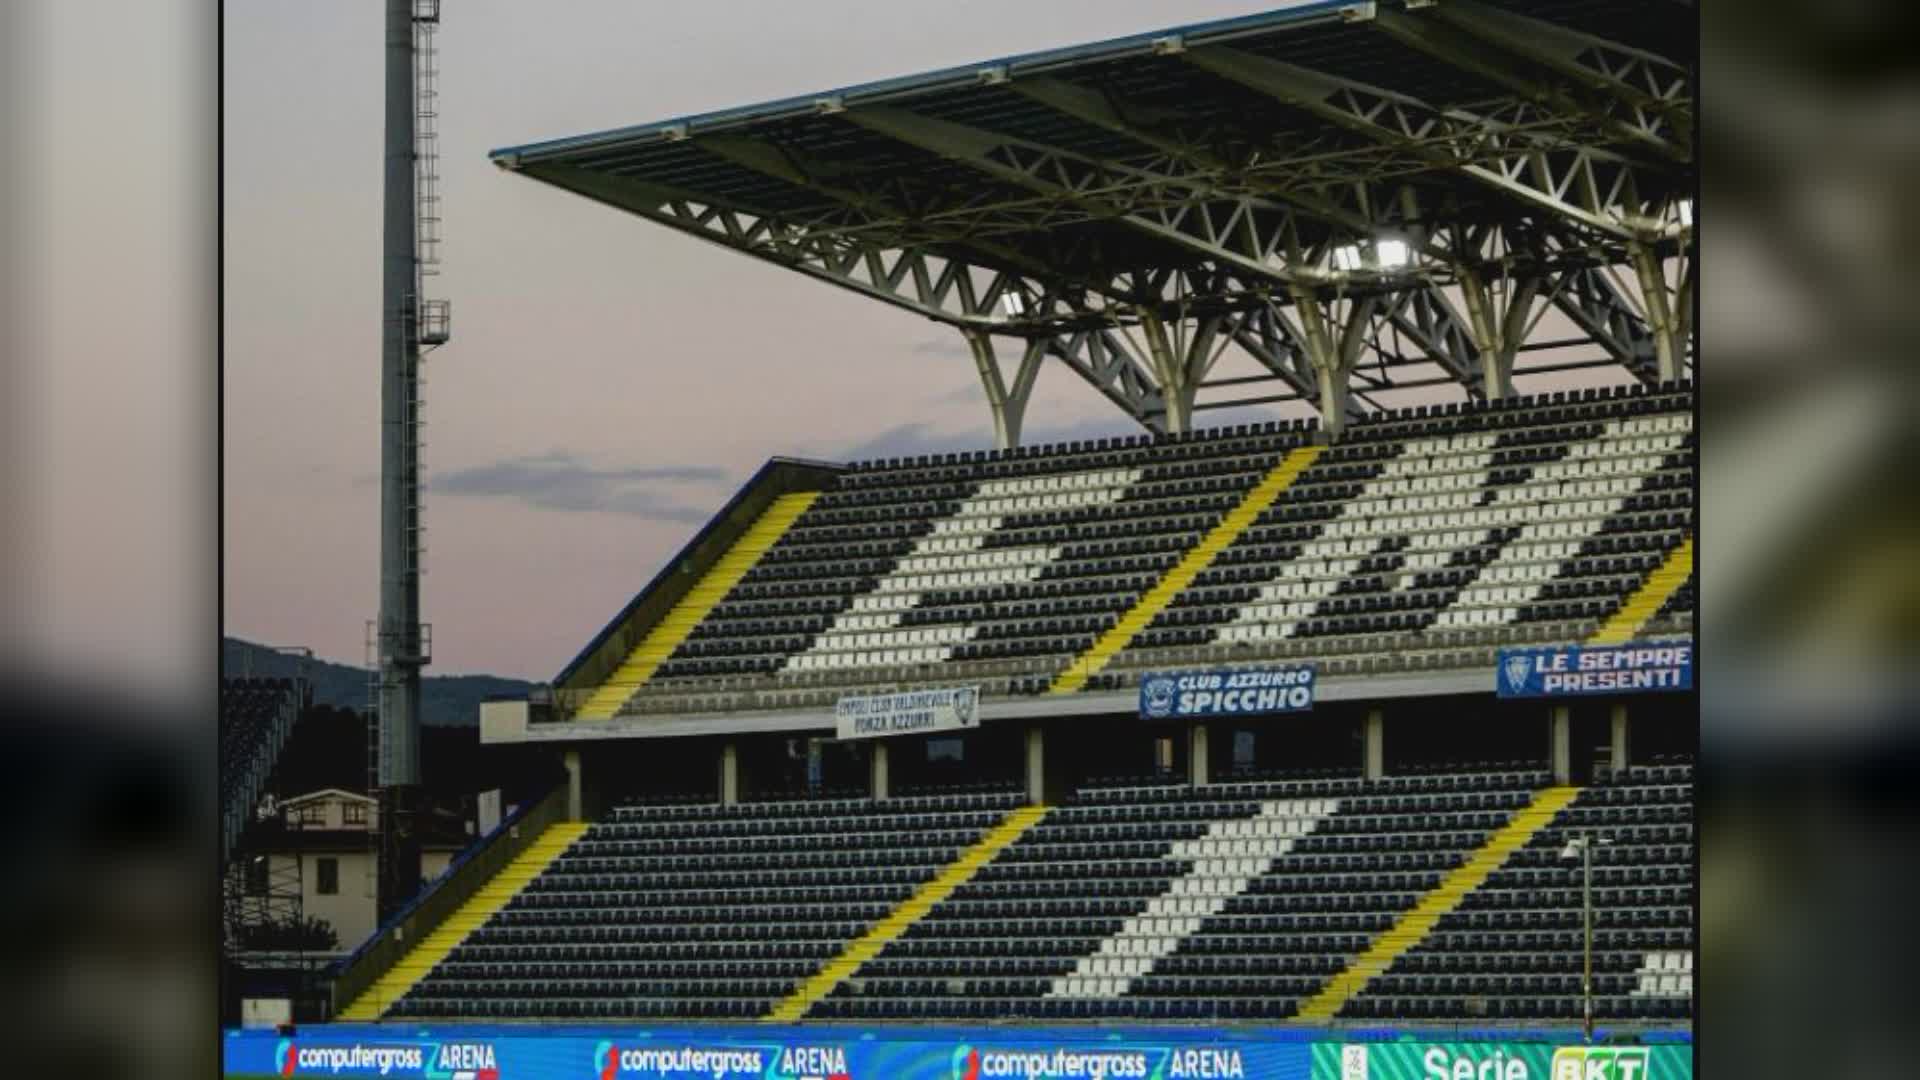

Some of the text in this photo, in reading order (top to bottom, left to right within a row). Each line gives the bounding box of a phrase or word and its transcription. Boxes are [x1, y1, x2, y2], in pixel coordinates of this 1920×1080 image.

[1536, 647, 1690, 673] LE SEMPRE
[1178, 670, 1312, 690] CLUB AZZURRO
[1544, 668, 1680, 692] PRESENTI
[1177, 687, 1311, 713] SPICCHIO
[891, 711, 935, 729] AZZURRI
[299, 1044, 497, 1074] computergross ARENA
[621, 1047, 848, 1079] computergross ARENA
[982, 1049, 1244, 1080] computergross ARENA
[1424, 1047, 1528, 1080] Serie
